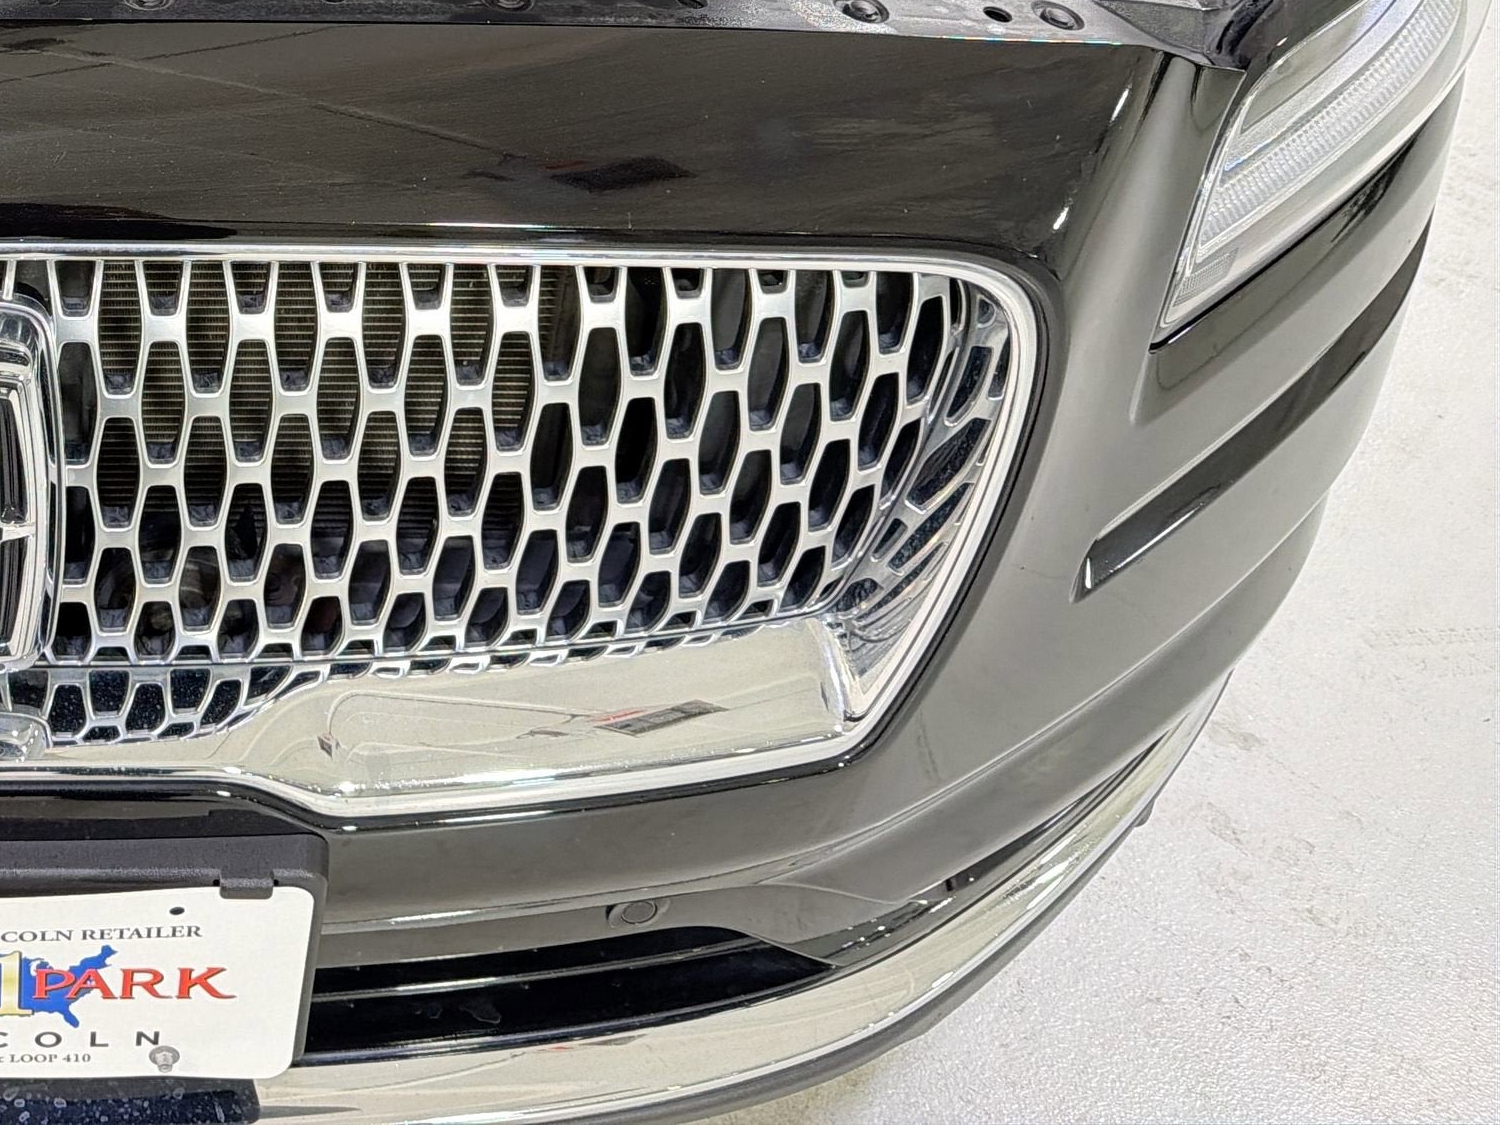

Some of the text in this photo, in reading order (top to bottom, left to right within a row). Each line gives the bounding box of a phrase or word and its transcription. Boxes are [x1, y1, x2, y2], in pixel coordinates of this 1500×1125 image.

[81, 925, 203, 941] RETAILER
[32, 967, 237, 1000] PARK
[10, 1053, 57, 1063] LOOP
[62, 1053, 91, 1063] 410
